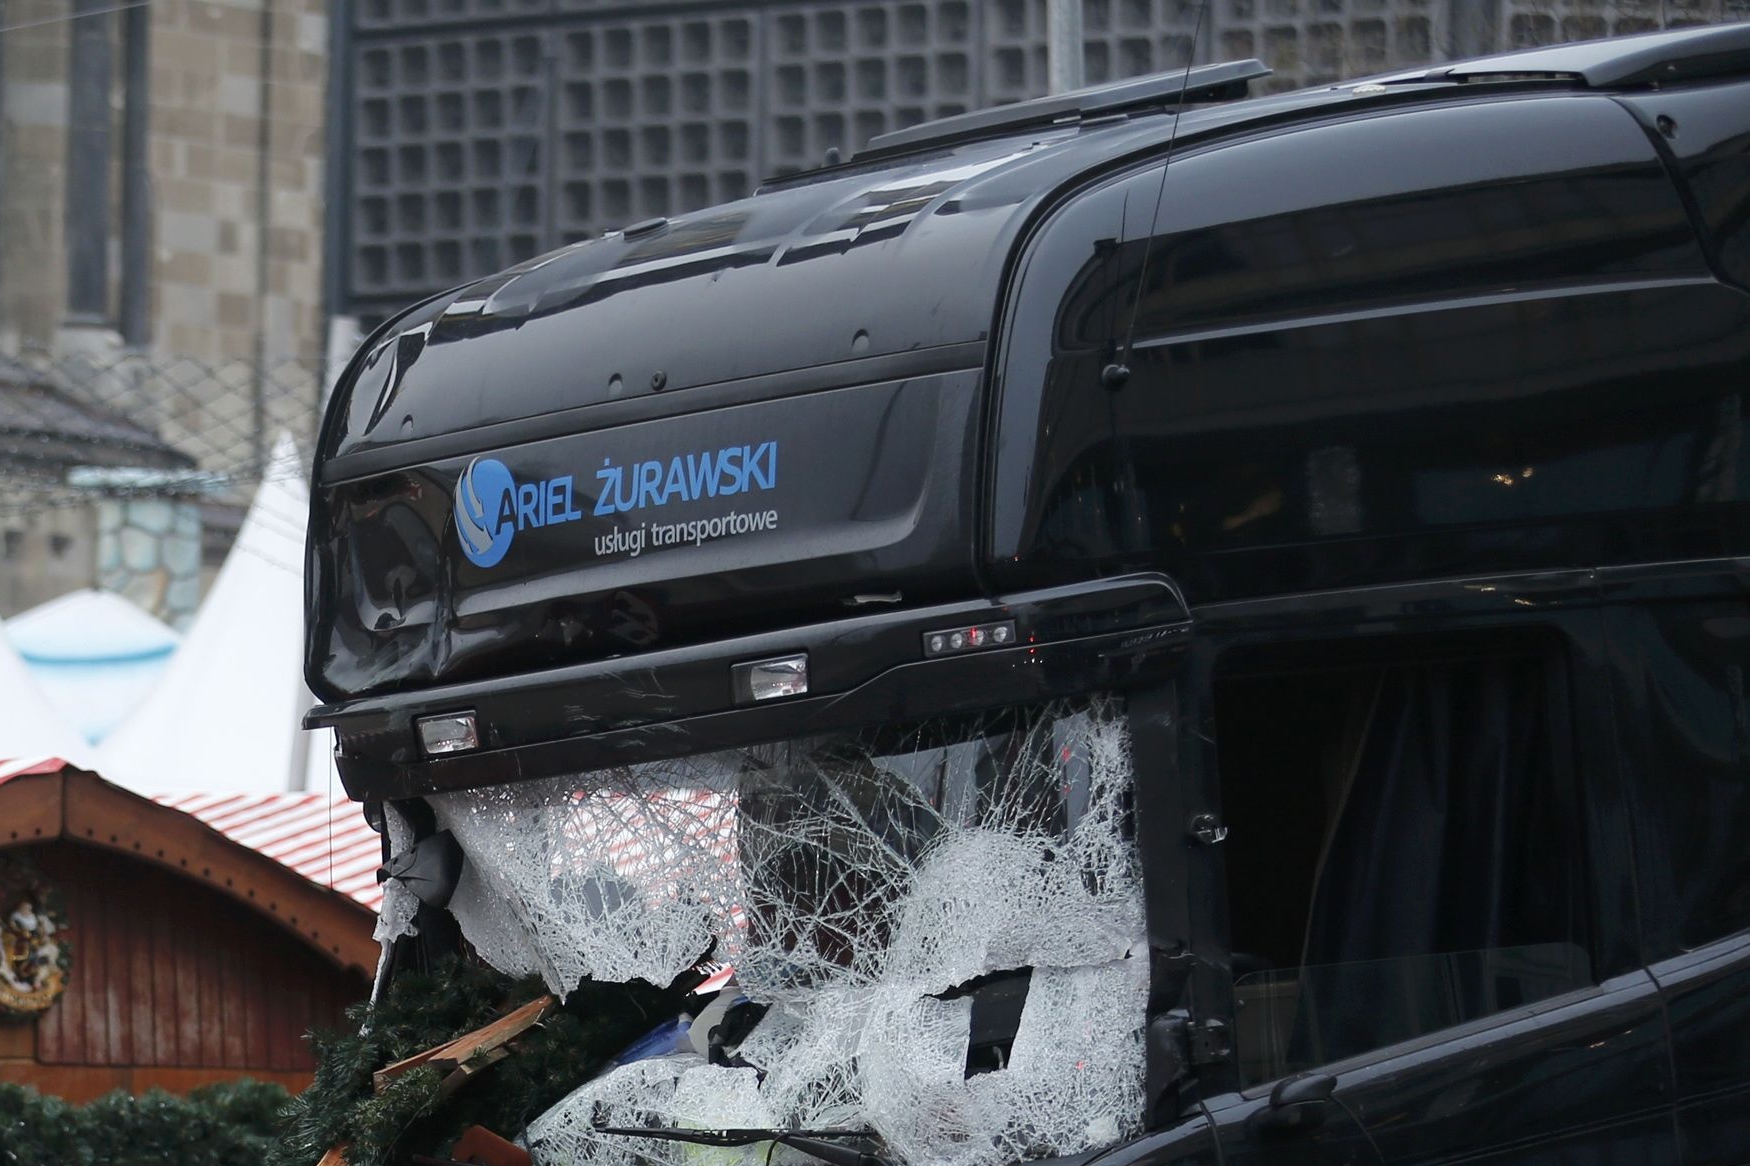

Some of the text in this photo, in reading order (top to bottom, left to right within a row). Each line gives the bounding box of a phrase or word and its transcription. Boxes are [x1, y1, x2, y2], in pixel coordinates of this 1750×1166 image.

[495, 442, 778, 536] ARIEL ŻURAWSKI
[594, 509, 778, 557] usługi transportowe
